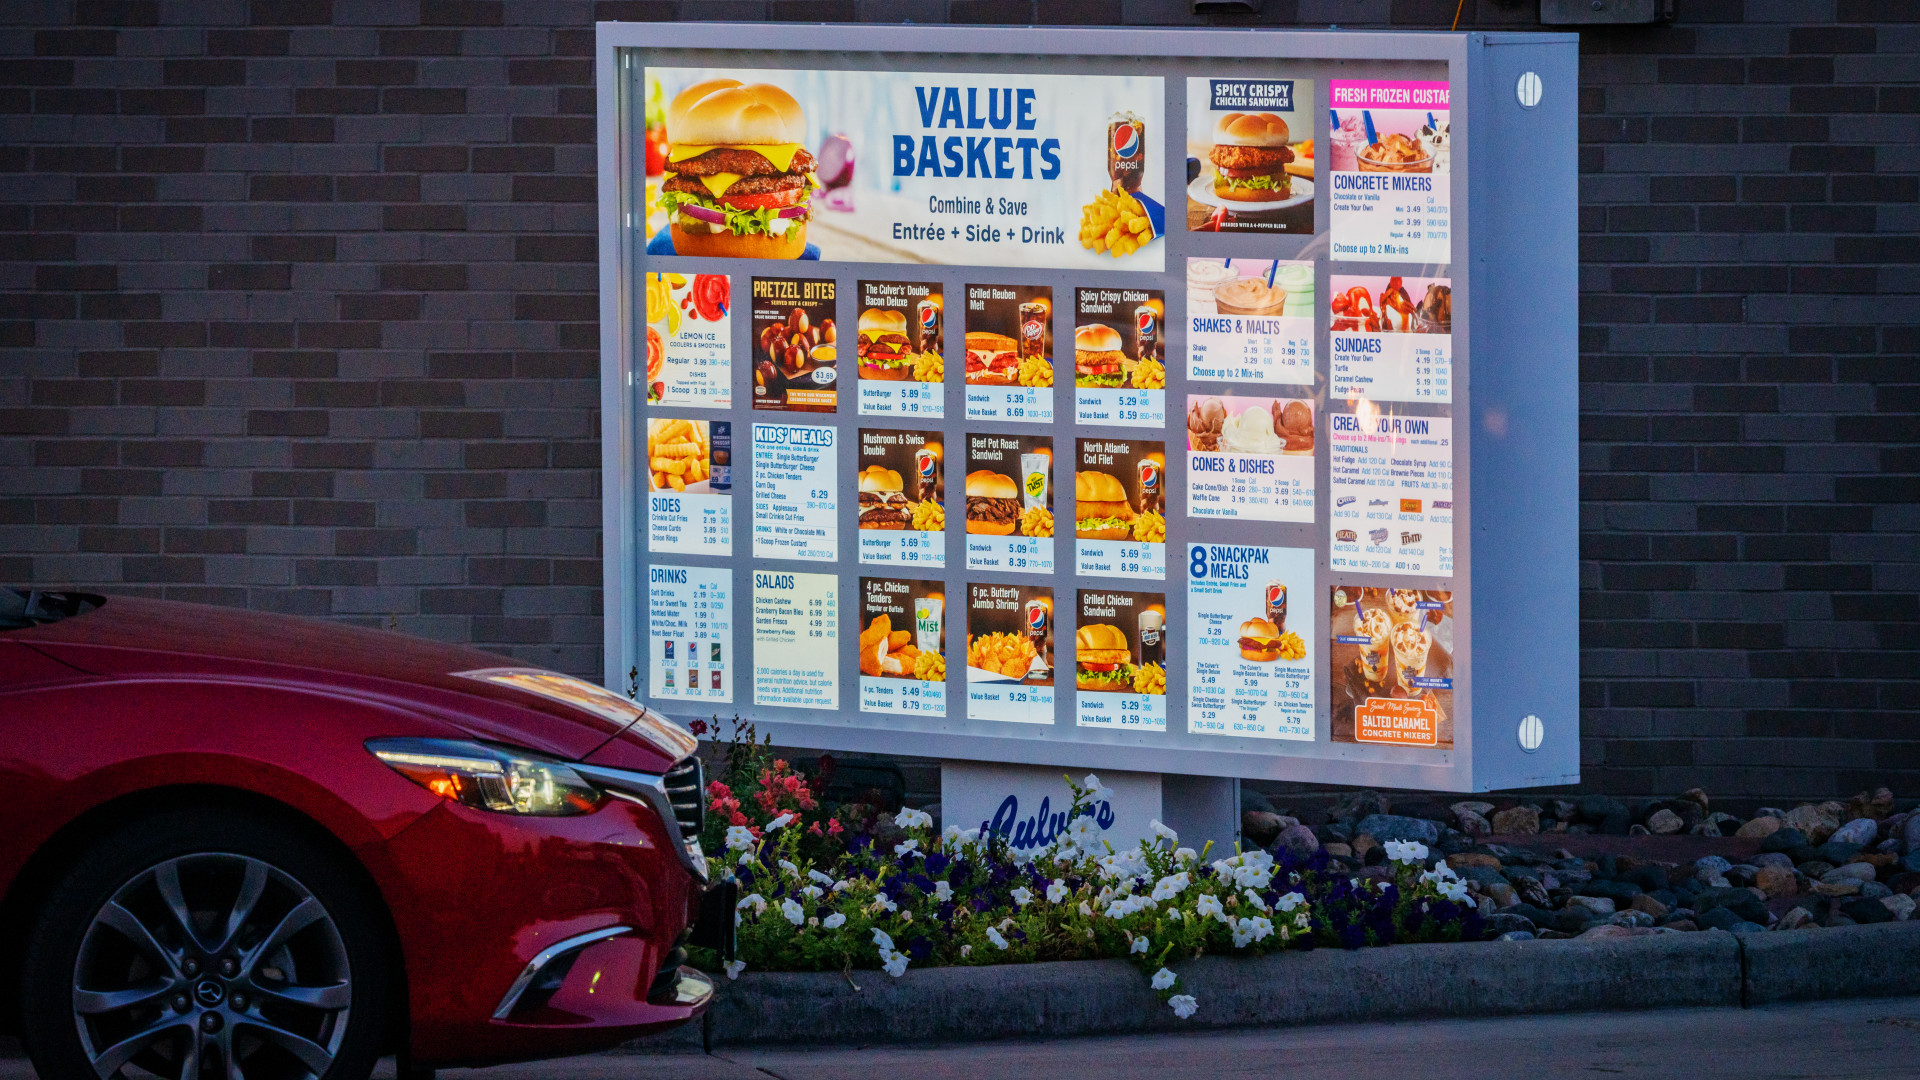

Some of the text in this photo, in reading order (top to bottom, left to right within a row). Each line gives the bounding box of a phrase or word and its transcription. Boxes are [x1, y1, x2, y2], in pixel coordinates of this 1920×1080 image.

[1216, 84, 1289, 97] SPICY CRISPY
[1335, 88, 1367, 102] FRESH
[1371, 89, 1410, 103] FROZEN
[1216, 97, 1288, 107] CHICKEN SANDWICH
[915, 87, 1037, 130] VALUE
[893, 135, 1061, 180] BASKETS
[1115, 159, 1139, 172] pepsi
[1335, 175, 1431, 191] CONCRETE MIXERS
[929, 196, 1027, 216] Combine & Save
[893, 222, 1064, 244] Entrée + Side + Drink
[1334, 243, 1408, 255] Choose up to 2 Mix-ins
[754, 281, 834, 299] PRETZEL BITES
[866, 284, 877, 294] The
[908, 286, 929, 295] Double
[970, 288, 1016, 299] Grilled Reuben
[866, 296, 907, 306] Bacon Deluxe
[1081, 290, 1148, 304] Spicy Crispy Chicken
[970, 300, 984, 310] Melt
[1081, 303, 1112, 313] Sandwich
[1193, 318, 1280, 335] SHAKES & MALTS
[1335, 338, 1381, 353] SUNDAES
[1193, 367, 1263, 378] Choose up to 2 Mix-ins
[902, 390, 918, 398] 5.89
[1007, 394, 1023, 403] 5.39
[1119, 397, 1136, 405] 5.29
[902, 403, 918, 412] 9.19
[1007, 408, 1023, 416] 8.69
[1120, 411, 1137, 420] 8.59
[1334, 416, 1363, 431] CREA
[1405, 420, 1428, 434] OWN
[755, 426, 832, 446] KIDS' MEALS
[864, 434, 924, 444] Mushroom & Swiss
[972, 438, 1018, 449] Beef Pot Roast
[1084, 442, 1129, 454] North Atlantic
[1333, 445, 1368, 453] TRADITIONALS
[864, 445, 885, 455] Double
[972, 450, 1002, 460] Sandwich
[1084, 454, 1113, 465] Cod Filet
[1193, 457, 1274, 474] CONES & DISHES
[1027, 478, 1044, 491] TWIST
[811, 490, 828, 499] 6.29
[652, 498, 680, 512] SIDES
[902, 538, 918, 547] 5.69
[1009, 544, 1026, 553] 5.09
[1121, 549, 1138, 558] 5.69
[902, 552, 918, 560] 8.99
[1009, 558, 1026, 567] 8.39
[1121, 563, 1138, 572] 8.99
[1190, 546, 1269, 578] 8 SNACKPAK
[652, 569, 686, 583] DRINKS
[1211, 563, 1248, 579] MEALS
[756, 574, 794, 589] SALADS
[867, 581, 909, 593] 4 pc. Chicken
[867, 592, 891, 603] Tenders
[973, 587, 1019, 600] 6 pc. Butterfly
[973, 598, 1018, 612] Jumbo Shrimp
[1084, 594, 1132, 606] Grilled Chicken
[867, 604, 882, 612] Regular
[1084, 606, 1115, 617] Sandwich
[919, 620, 938, 632] Mist
[902, 687, 919, 696] 5.49
[1010, 693, 1026, 702] 9.29
[902, 701, 919, 709] 8.79
[1122, 701, 1138, 710] 5.29
[1122, 715, 1139, 724] 8.59
[1363, 715, 1430, 730] SALTED CARAMEL
[1363, 729, 1430, 739] CONCRETE MIXERS
